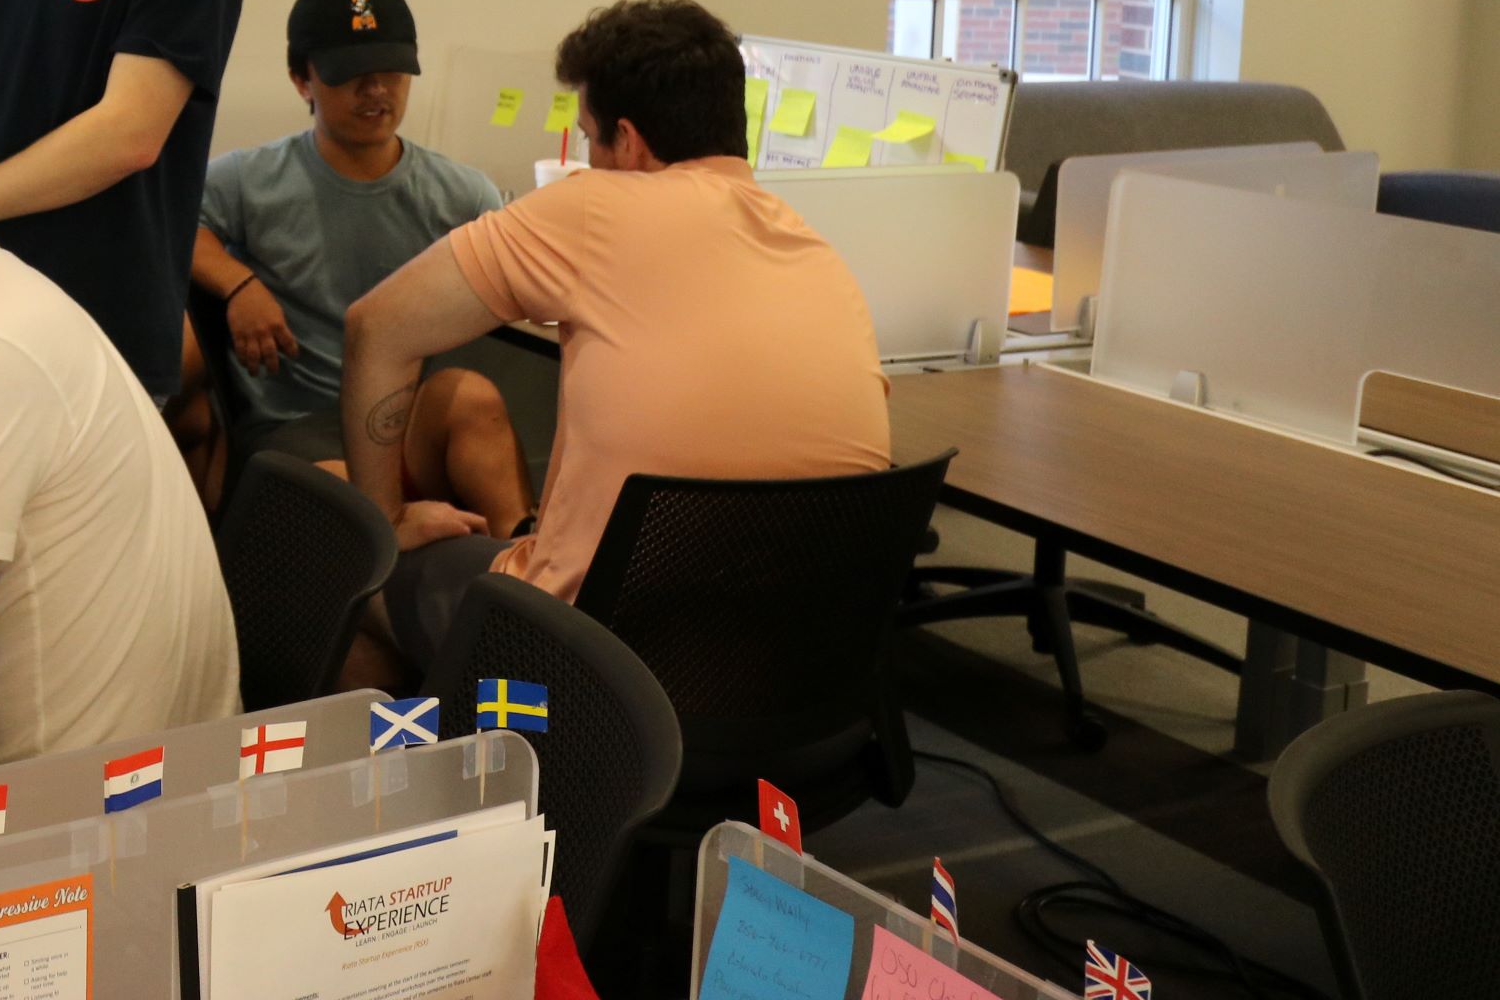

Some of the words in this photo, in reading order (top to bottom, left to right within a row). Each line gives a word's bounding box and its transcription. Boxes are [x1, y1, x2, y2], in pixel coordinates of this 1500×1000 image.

[53, 885, 88, 908] Note
[344, 895, 386, 918] RIATA
[389, 876, 453, 906] STARTUP
[343, 894, 450, 941] EXPERIENCE
[355, 936, 377, 948] LEARN
[381, 926, 409, 941] ENGAGE
[412, 918, 439, 932] LAUNCH
[358, 953, 381, 965] Startup
[381, 945, 413, 959] Experience
